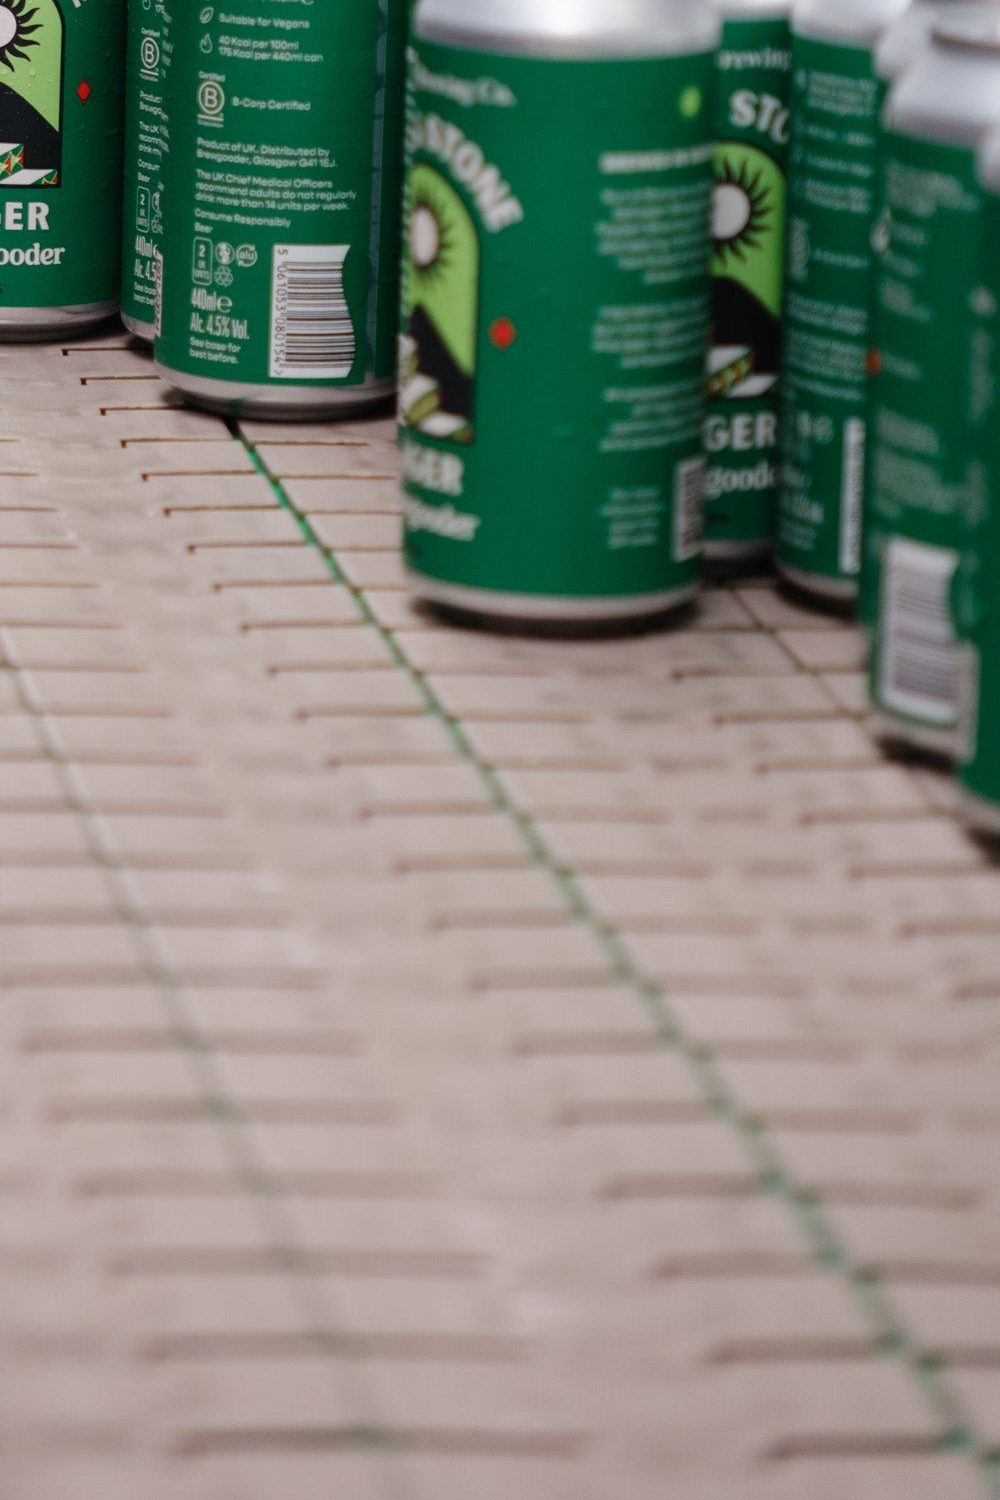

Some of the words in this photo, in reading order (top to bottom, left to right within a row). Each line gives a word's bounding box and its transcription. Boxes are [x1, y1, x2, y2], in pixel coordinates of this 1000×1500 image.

[219, 13, 256, 26] Suitable
[257, 16, 271, 26] for
[273, 18, 310, 30] Vegans
[219, 36, 230, 45] 40
[231, 36, 251, 47] Kcal
[252, 40, 269, 50] per
[270, 40, 299, 50] 100ml
[219, 47, 232, 56] 175
[233, 47, 253, 58] Kcal
[254, 51, 271, 60] per
[272, 51, 303, 62] 440ml
[304, 54, 323, 62] can
[204, 87, 218, 108] B
[232, 96, 267, 111] B-Corp
[268, 99, 311, 111] Certified
[197, 137, 230, 150] Product
[231, 142, 241, 151] of
[242, 143, 259, 153] UK.
[260, 145, 316, 156] Distributed
[318, 147, 330, 158] by
[197, 149, 251, 165] Brewgooder,
[252, 156, 298, 168] Glasgow
[299, 159, 318, 168] G41
[196, 169, 212, 180] The
[212, 172, 225, 182] UK
[225, 174, 252, 185] Chief
[252, 178, 292, 188] Medical
[294, 179, 333, 188] Officers
[196, 182, 249, 197] recommend
[250, 187, 281, 199] adults
[282, 190, 296, 199] do
[297, 191, 315, 200] not
[316, 190, 357, 201] regularly
[195, 192, 216, 203] drink
[217, 197, 240, 206] more
[241, 198, 264, 208] than
[277, 200, 302, 210] units
[303, 203, 320, 212] per
[322, 201, 350, 211] week.
[194, 222, 213, 234] Beer
[195, 208, 233, 222] Consume
[234, 213, 291, 229] Responsibly
[199, 245, 206, 258] 2
[191, 287, 217, 312] 440ml
[190, 312, 206, 334] Alc.
[206, 314, 232, 338] 4.5%
[232, 319, 250, 339] Vol.
[190, 337, 205, 348] See
[205, 340, 227, 352] base
[227, 342, 241, 353] for
[189, 350, 208, 360] best
[208, 351, 239, 364] before.
